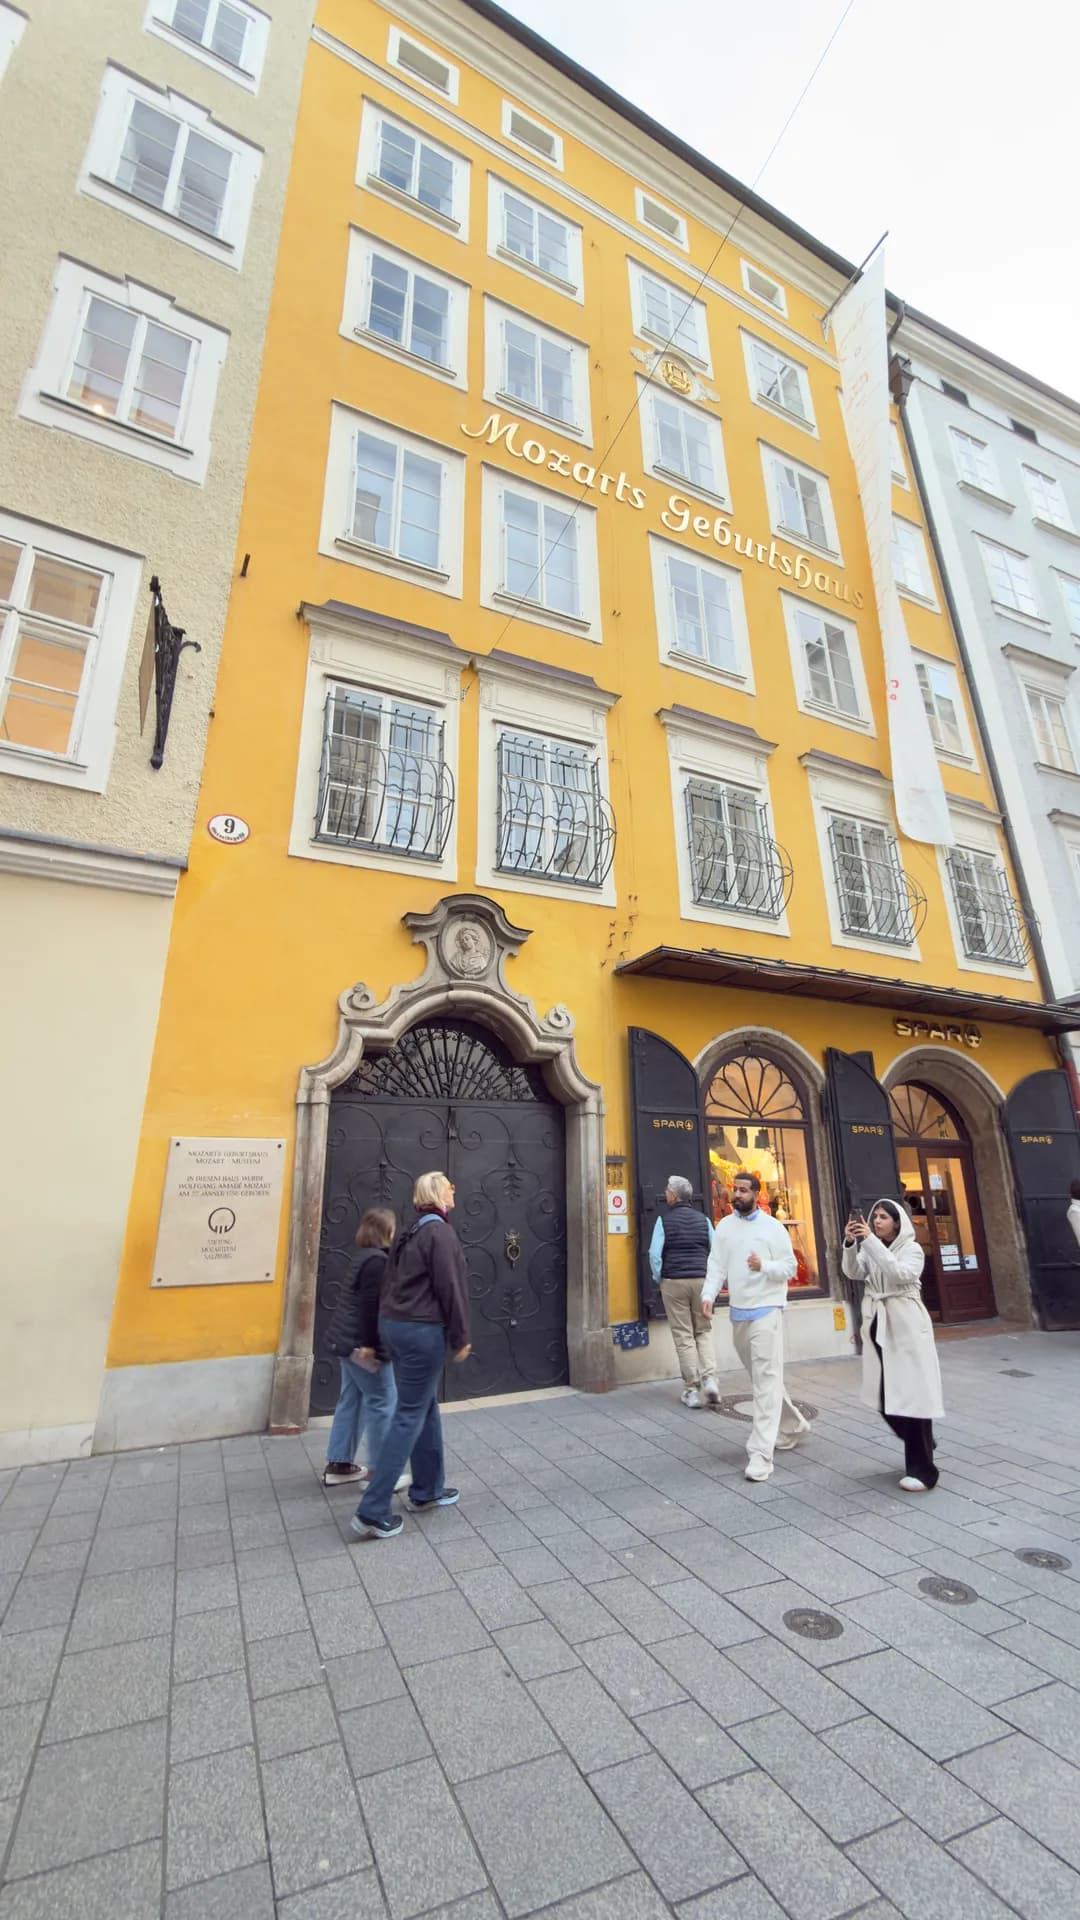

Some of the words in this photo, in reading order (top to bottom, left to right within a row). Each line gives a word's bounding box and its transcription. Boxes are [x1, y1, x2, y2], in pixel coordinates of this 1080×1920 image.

[459, 412, 648, 511] Mozarts
[660, 493, 866, 610] Geburtshaus
[224, 818, 236, 834] 9
[895, 1017, 963, 1043] SPAR
[652, 1119, 685, 1129] SPAR
[851, 1125, 877, 1134] SPAR
[1020, 1135, 1045, 1144] SPAR
